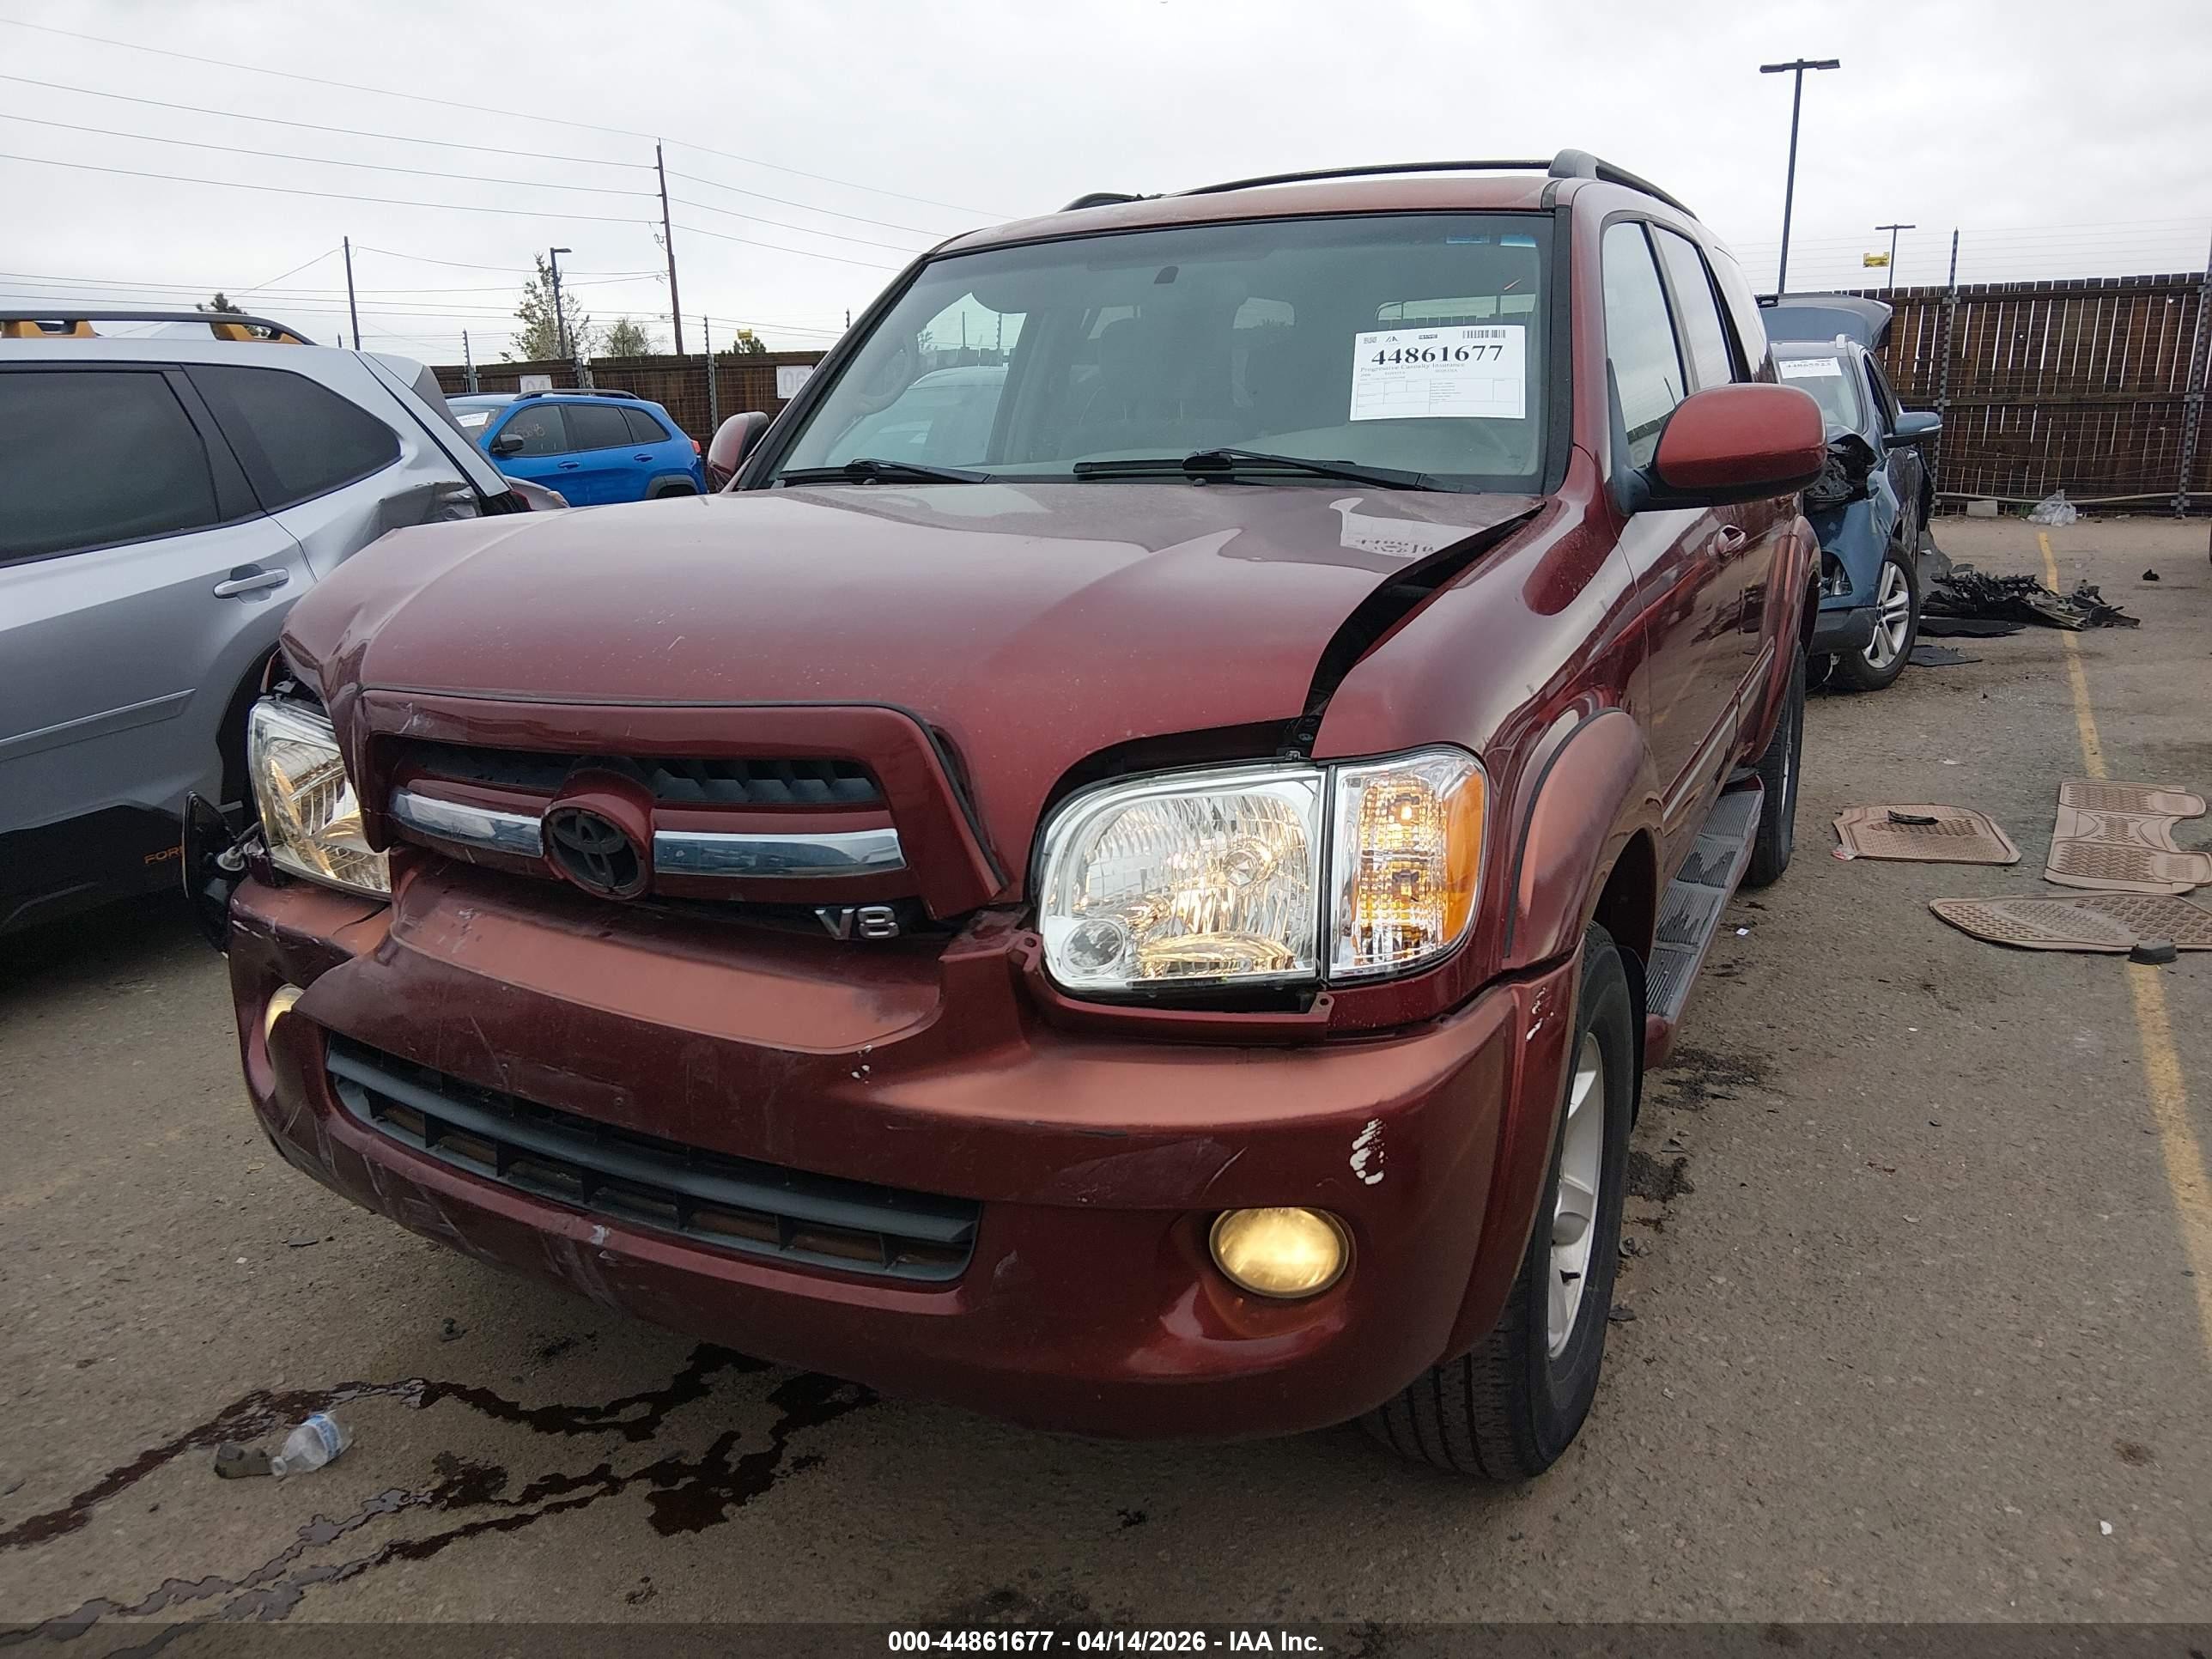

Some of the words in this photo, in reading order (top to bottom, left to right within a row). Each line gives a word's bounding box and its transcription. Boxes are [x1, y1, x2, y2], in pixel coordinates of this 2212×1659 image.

[1371, 345, 1504, 366] 44861677
[143, 846, 183, 864] FOR
[815, 906, 900, 940] V8
